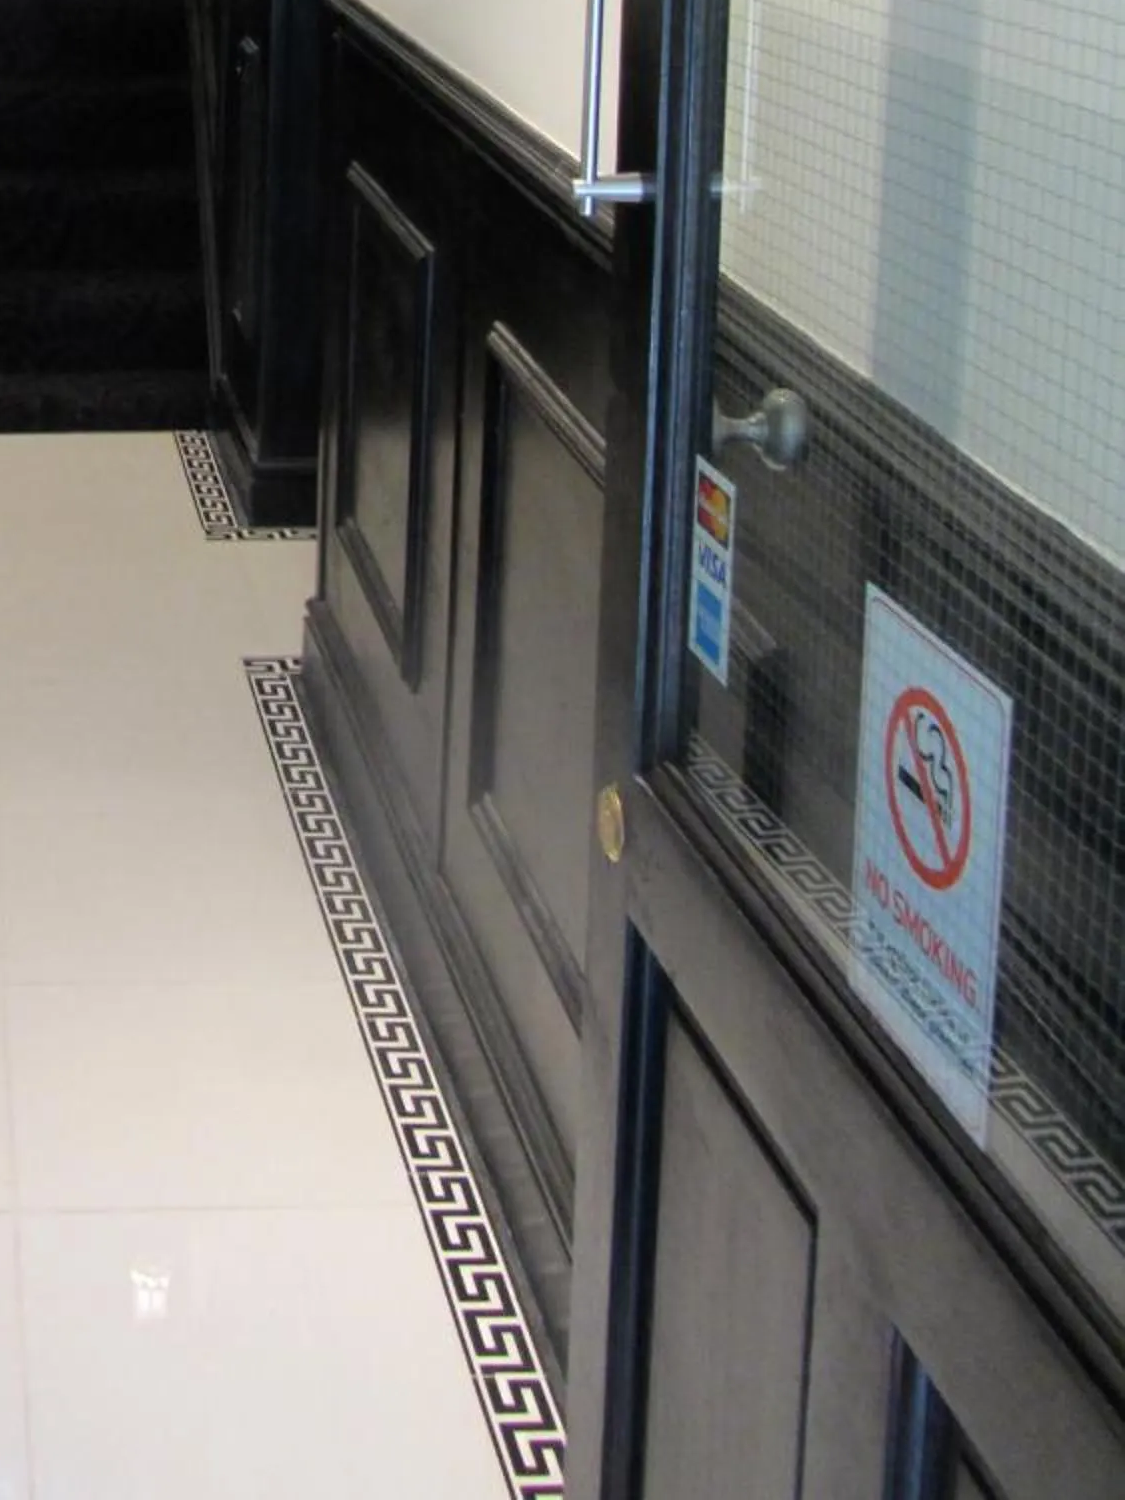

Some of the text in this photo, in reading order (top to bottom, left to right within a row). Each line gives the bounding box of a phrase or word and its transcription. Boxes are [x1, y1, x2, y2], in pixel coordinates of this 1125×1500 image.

[698, 539, 727, 588] VISA
[864, 858, 890, 911] NO
[892, 888, 978, 1009] SMOKING
